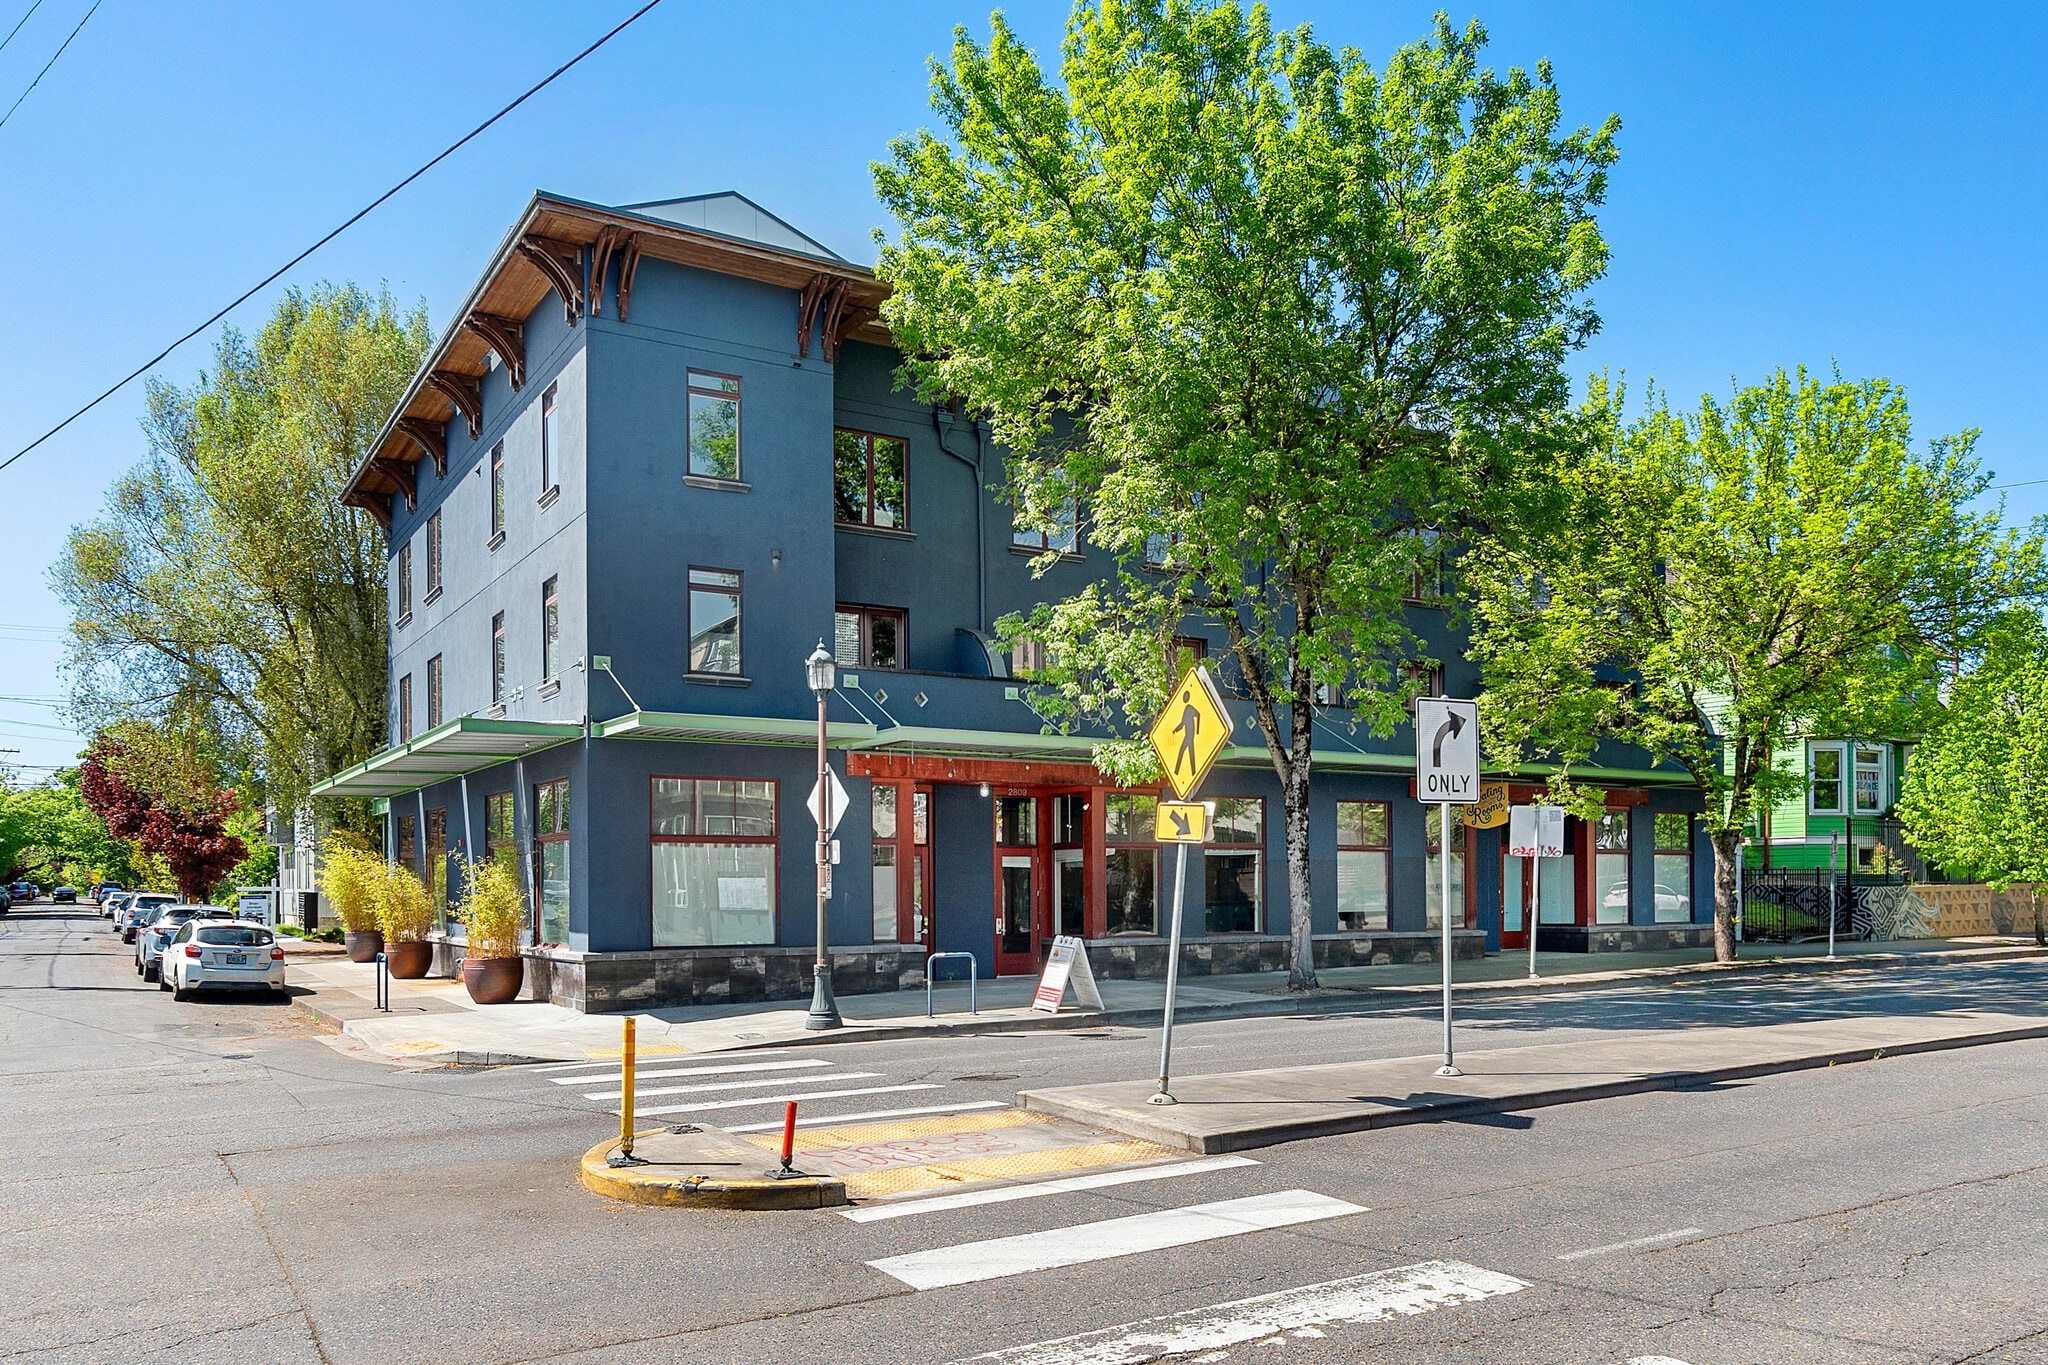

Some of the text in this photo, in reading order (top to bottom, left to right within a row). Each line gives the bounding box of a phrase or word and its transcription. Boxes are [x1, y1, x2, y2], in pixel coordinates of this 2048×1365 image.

[1008, 788, 1027, 796] 2809
[1428, 774, 1470, 793] ONLY
[1469, 803, 1505, 825] Rooms
